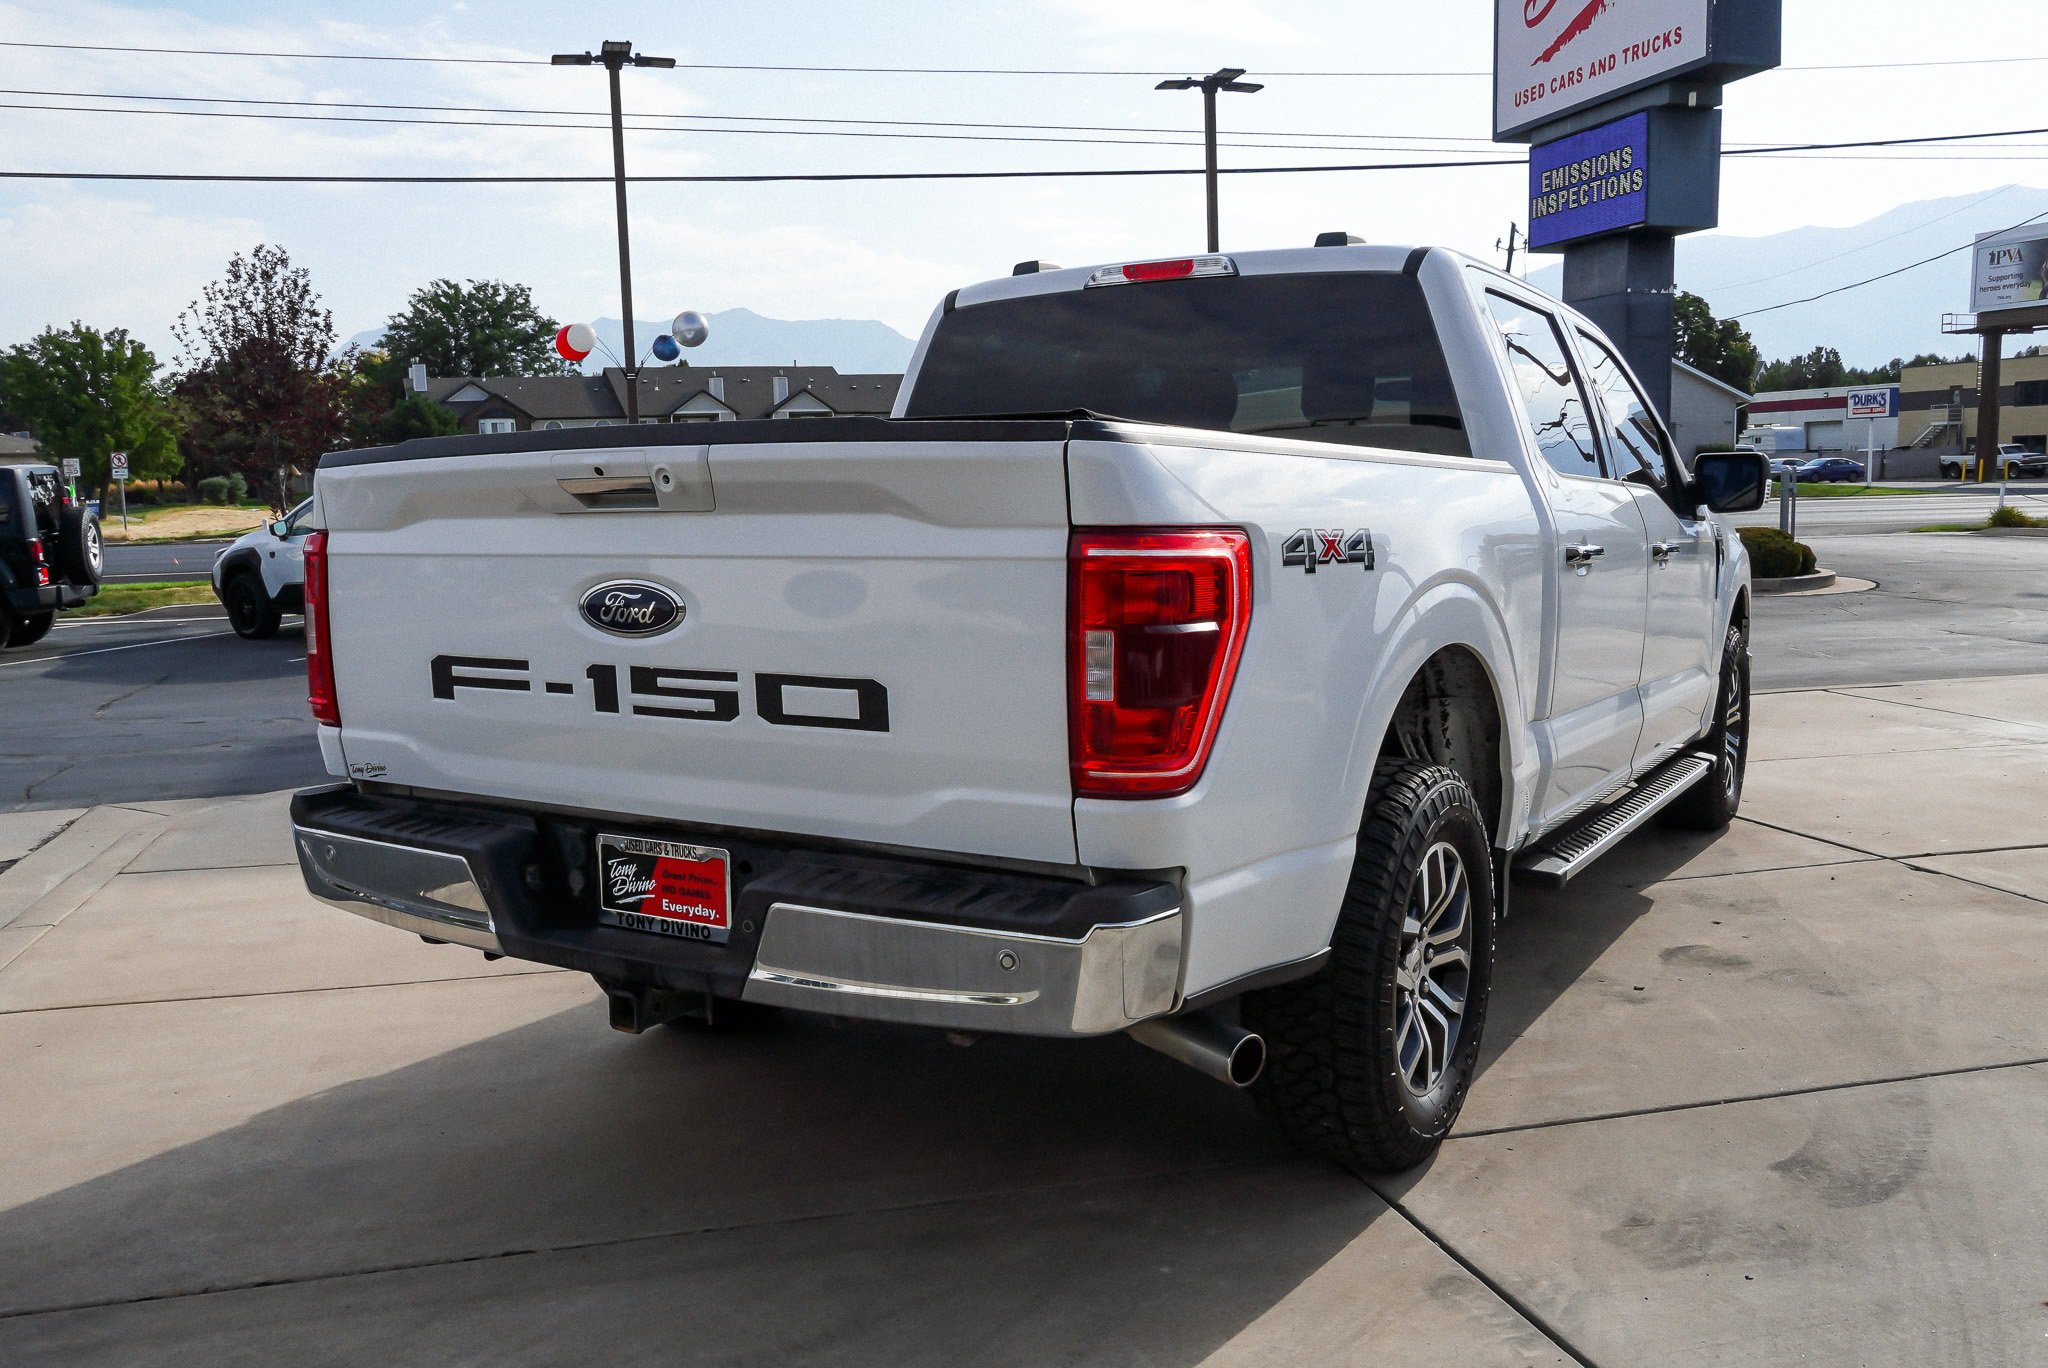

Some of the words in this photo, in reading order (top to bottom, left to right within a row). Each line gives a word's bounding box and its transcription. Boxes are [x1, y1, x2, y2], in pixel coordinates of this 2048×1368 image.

[1514, 82, 1545, 107] USED
[1550, 67, 1583, 93] CARS
[1588, 53, 1616, 79] AND
[1622, 26, 1682, 64] TRUCKS
[1541, 146, 1633, 193] EMISSIONS
[1532, 168, 1643, 219] INSPECTIONS
[1979, 285, 2001, 293] heroes
[2002, 281, 2031, 290] everyday
[1988, 273, 2023, 282] Supporting
[1850, 393, 1886, 406] DURK'S
[600, 591, 656, 624] Ford
[430, 654, 890, 732] F-150
[350, 763, 364, 776] Tony
[625, 839, 643, 852] USED
[645, 841, 662, 855] CARS
[664, 843, 669, 856] &
[671, 844, 697, 859] TRUCKS
[607, 857, 638, 881] Tony
[608, 876, 657, 896] Divino
[662, 884, 676, 894] NO
[662, 899, 720, 920] Everyday.
[617, 912, 655, 930] TONY
[660, 919, 711, 939] DIVINO
